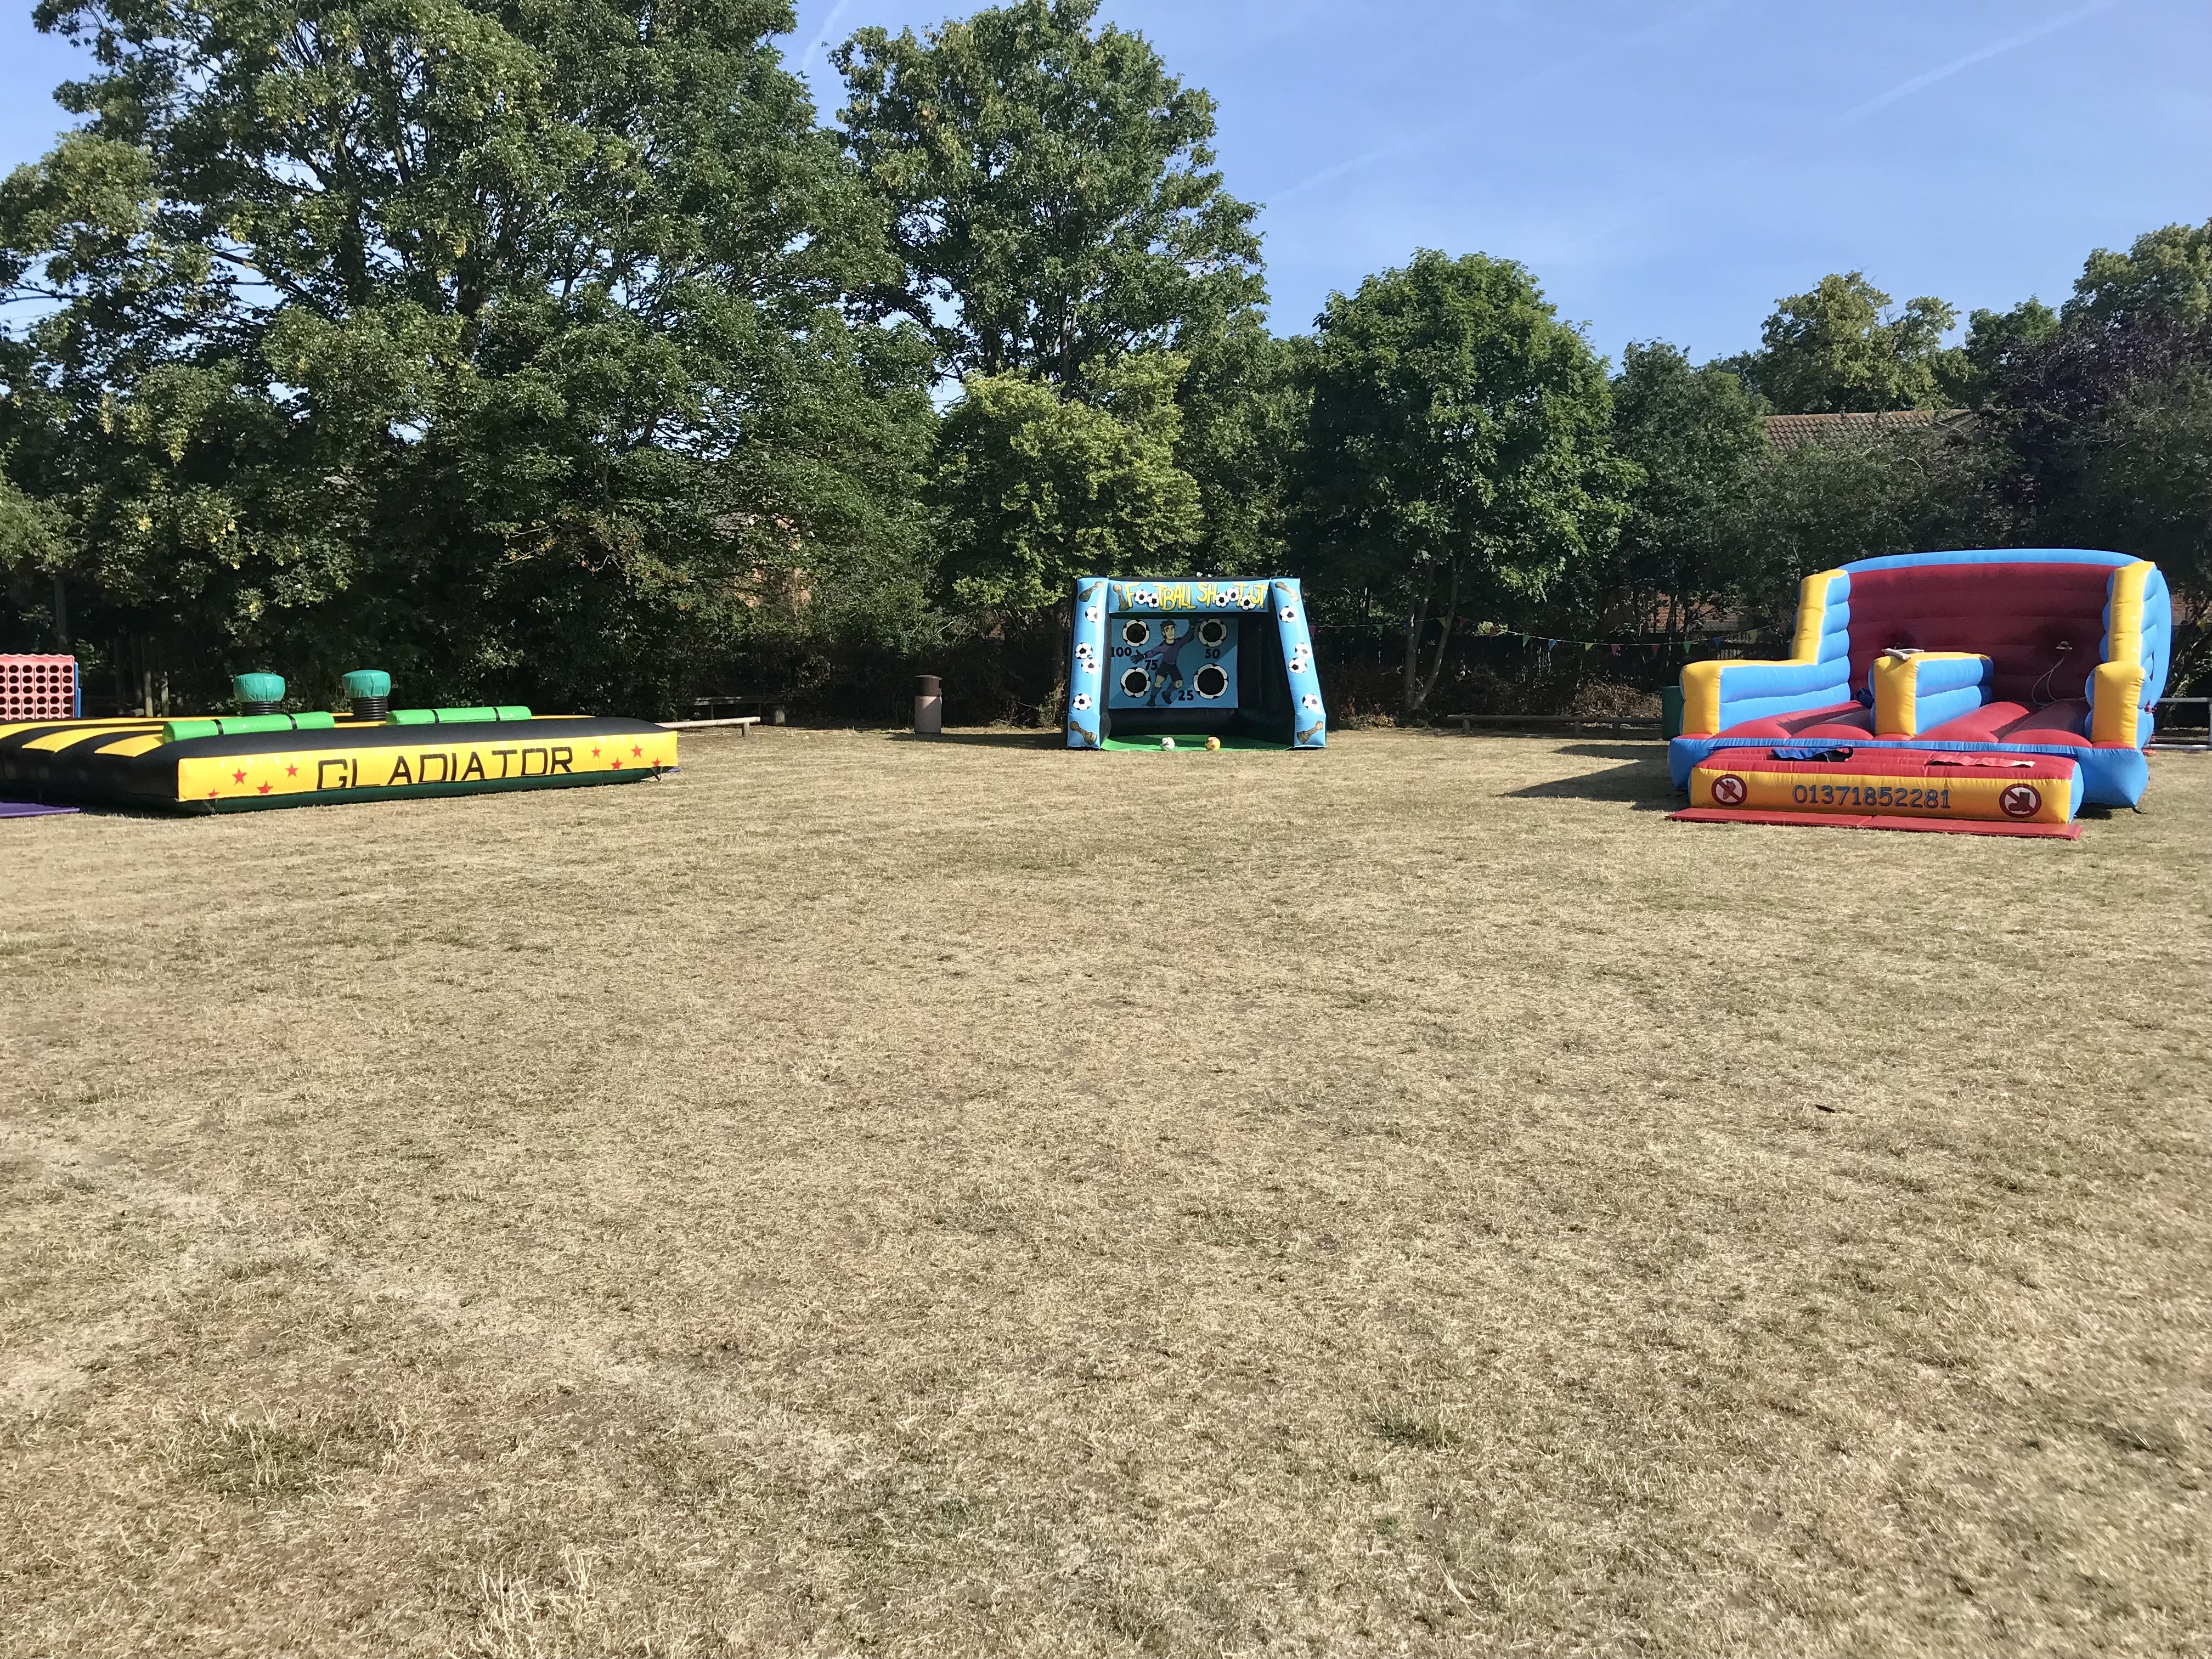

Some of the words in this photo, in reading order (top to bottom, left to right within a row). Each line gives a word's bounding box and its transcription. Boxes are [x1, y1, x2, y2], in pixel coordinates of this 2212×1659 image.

[1124, 582, 1197, 611] FOOTBALL
[1111, 646, 1132, 657] 100
[1205, 648, 1221, 659] 50
[1144, 659, 1159, 670] 75
[1178, 690, 1194, 701] 25
[317, 747, 573, 791] GLADIATOR
[1792, 785, 1951, 809] 01371852281
